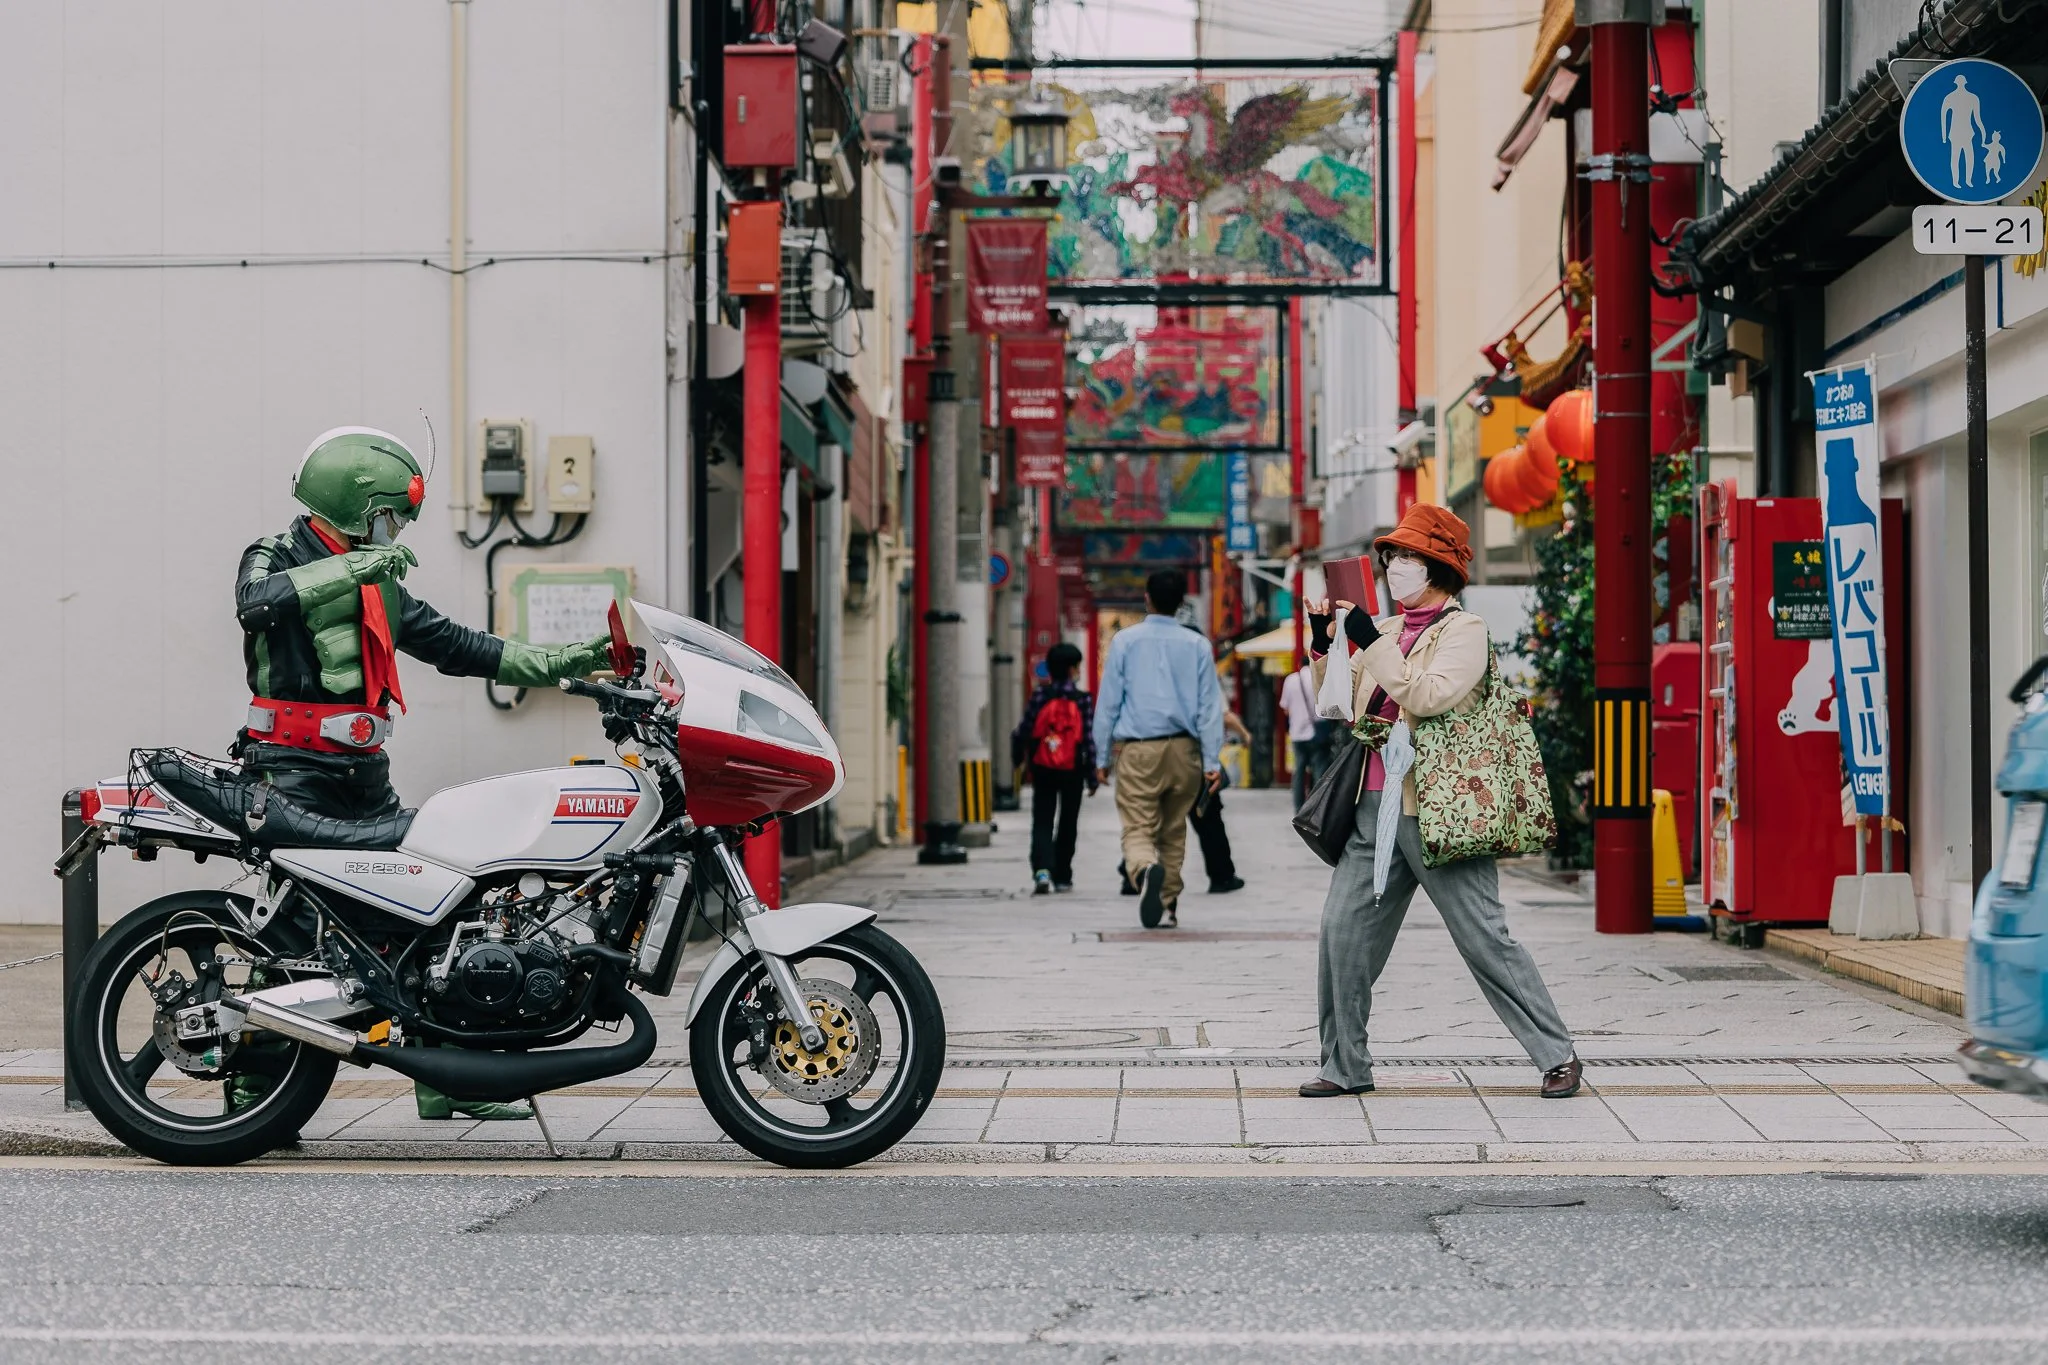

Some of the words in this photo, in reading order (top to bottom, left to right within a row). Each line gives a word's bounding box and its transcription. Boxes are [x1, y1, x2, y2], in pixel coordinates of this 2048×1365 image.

[1826, 384, 1854, 403] かつおの
[1833, 537, 1882, 757] レバコール
[567, 797, 626, 814] YAMAHA
[345, 862, 370, 874] RZ
[372, 862, 408, 875] 250
